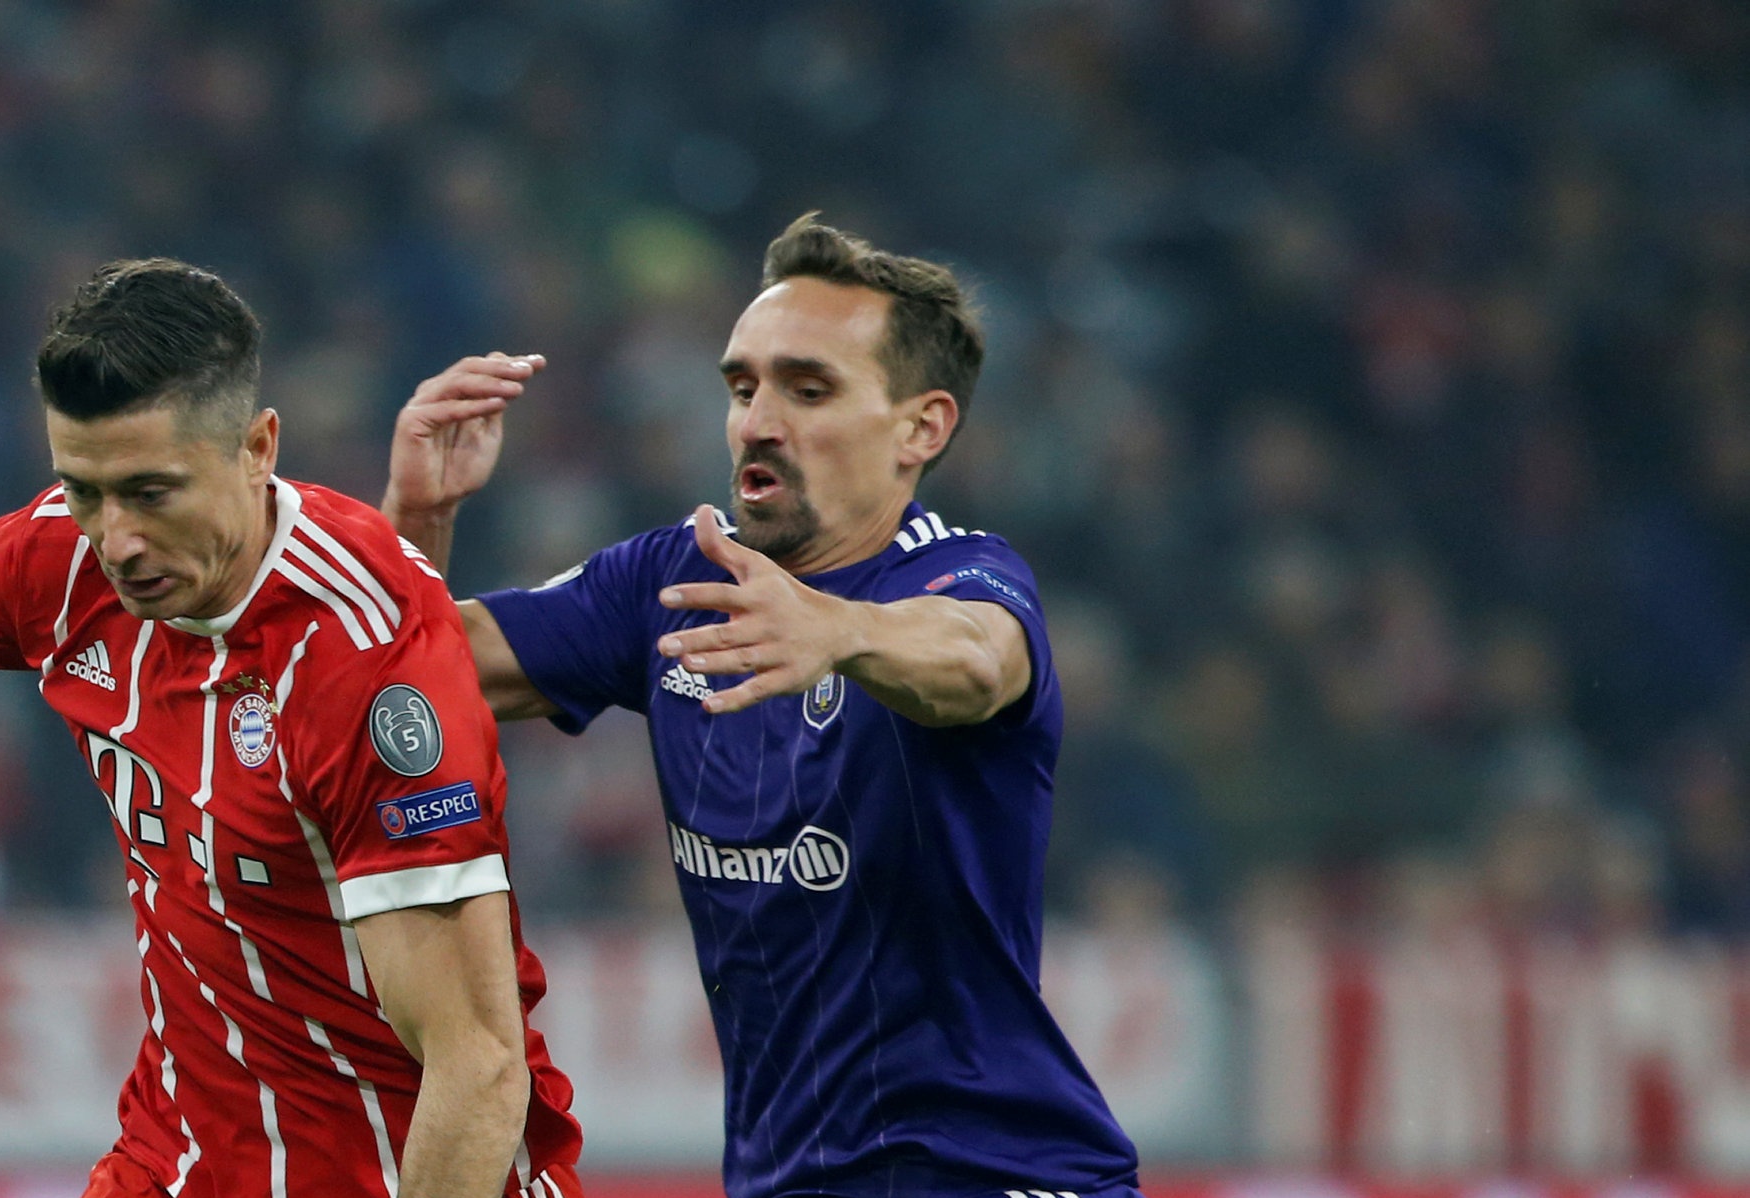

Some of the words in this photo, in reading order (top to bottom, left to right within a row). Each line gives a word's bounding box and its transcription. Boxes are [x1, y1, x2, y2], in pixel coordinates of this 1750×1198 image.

[65, 661, 117, 692] adidas
[233, 703, 246, 721] FC
[245, 698, 274, 733] BAYERN
[401, 727, 421, 752] 5
[405, 792, 478, 825] RESPECT
[669, 821, 790, 884] Allianz
